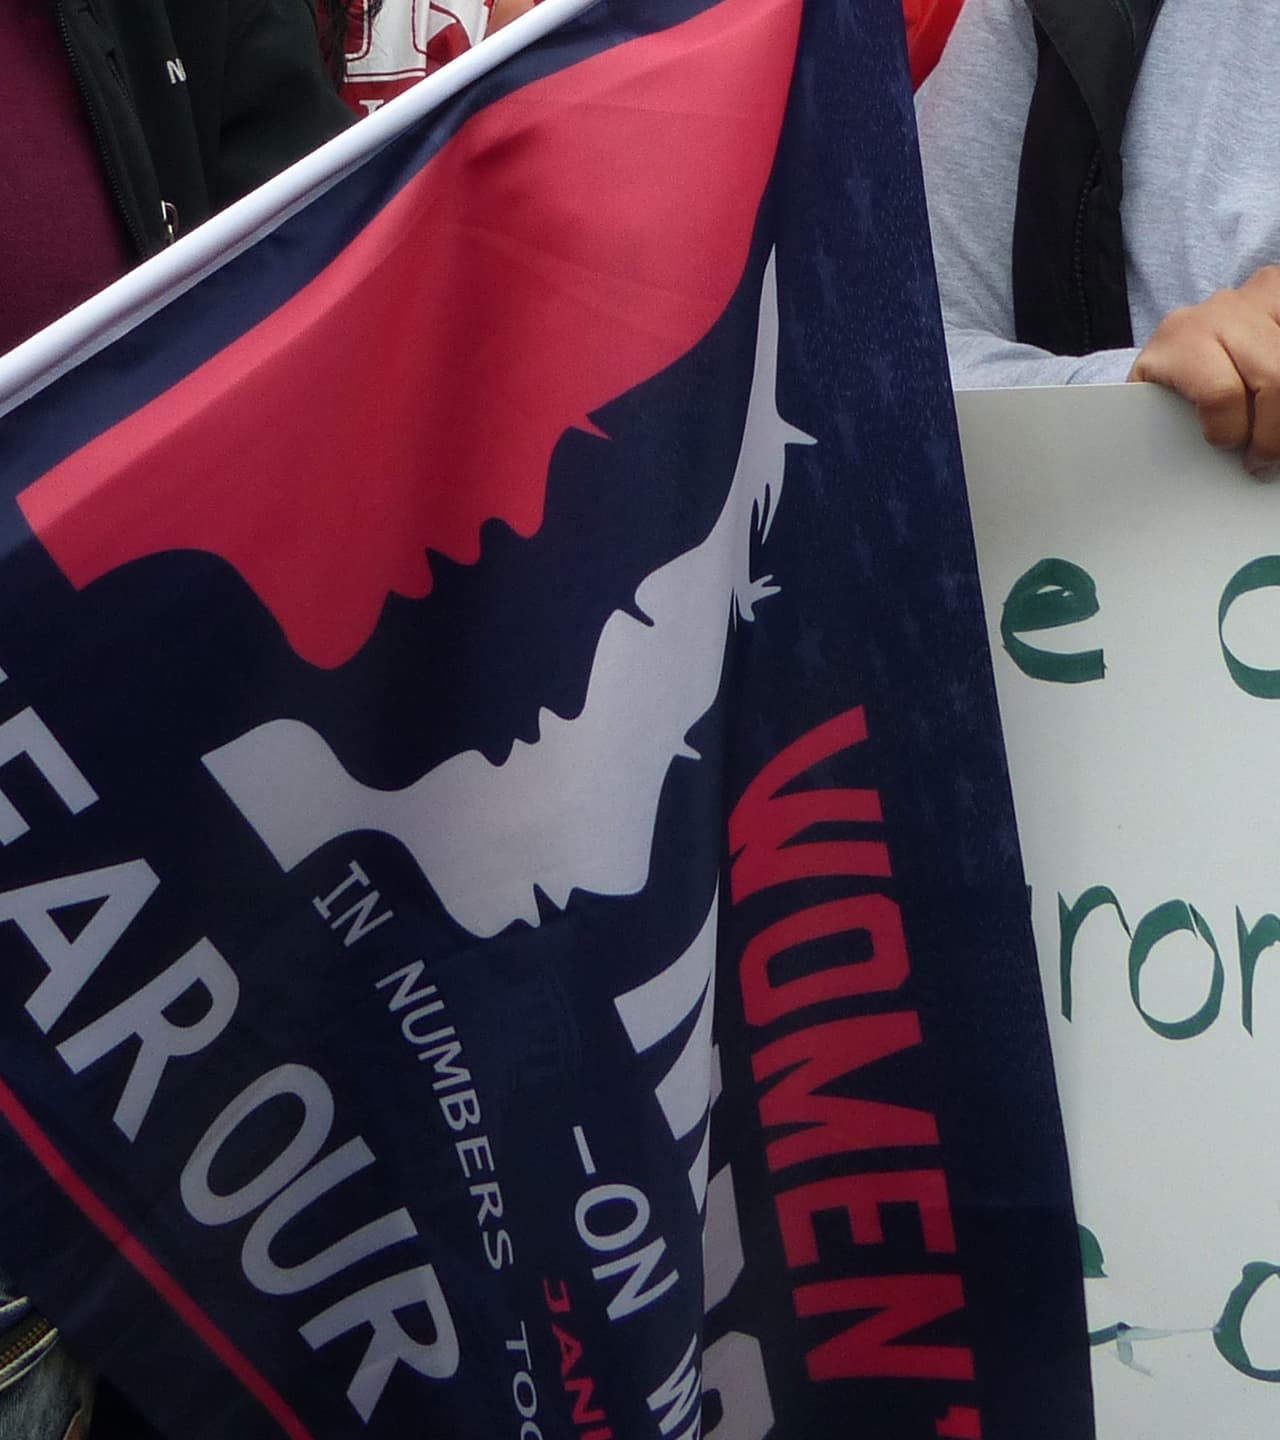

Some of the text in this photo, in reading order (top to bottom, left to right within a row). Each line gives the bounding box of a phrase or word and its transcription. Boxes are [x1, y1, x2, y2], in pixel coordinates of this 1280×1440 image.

[1000, 557, 1106, 683] e
[180, 1062, 461, 1424] OUR
[311, 859, 394, 948] IN
[374, 959, 514, 1271] NUMBERS
